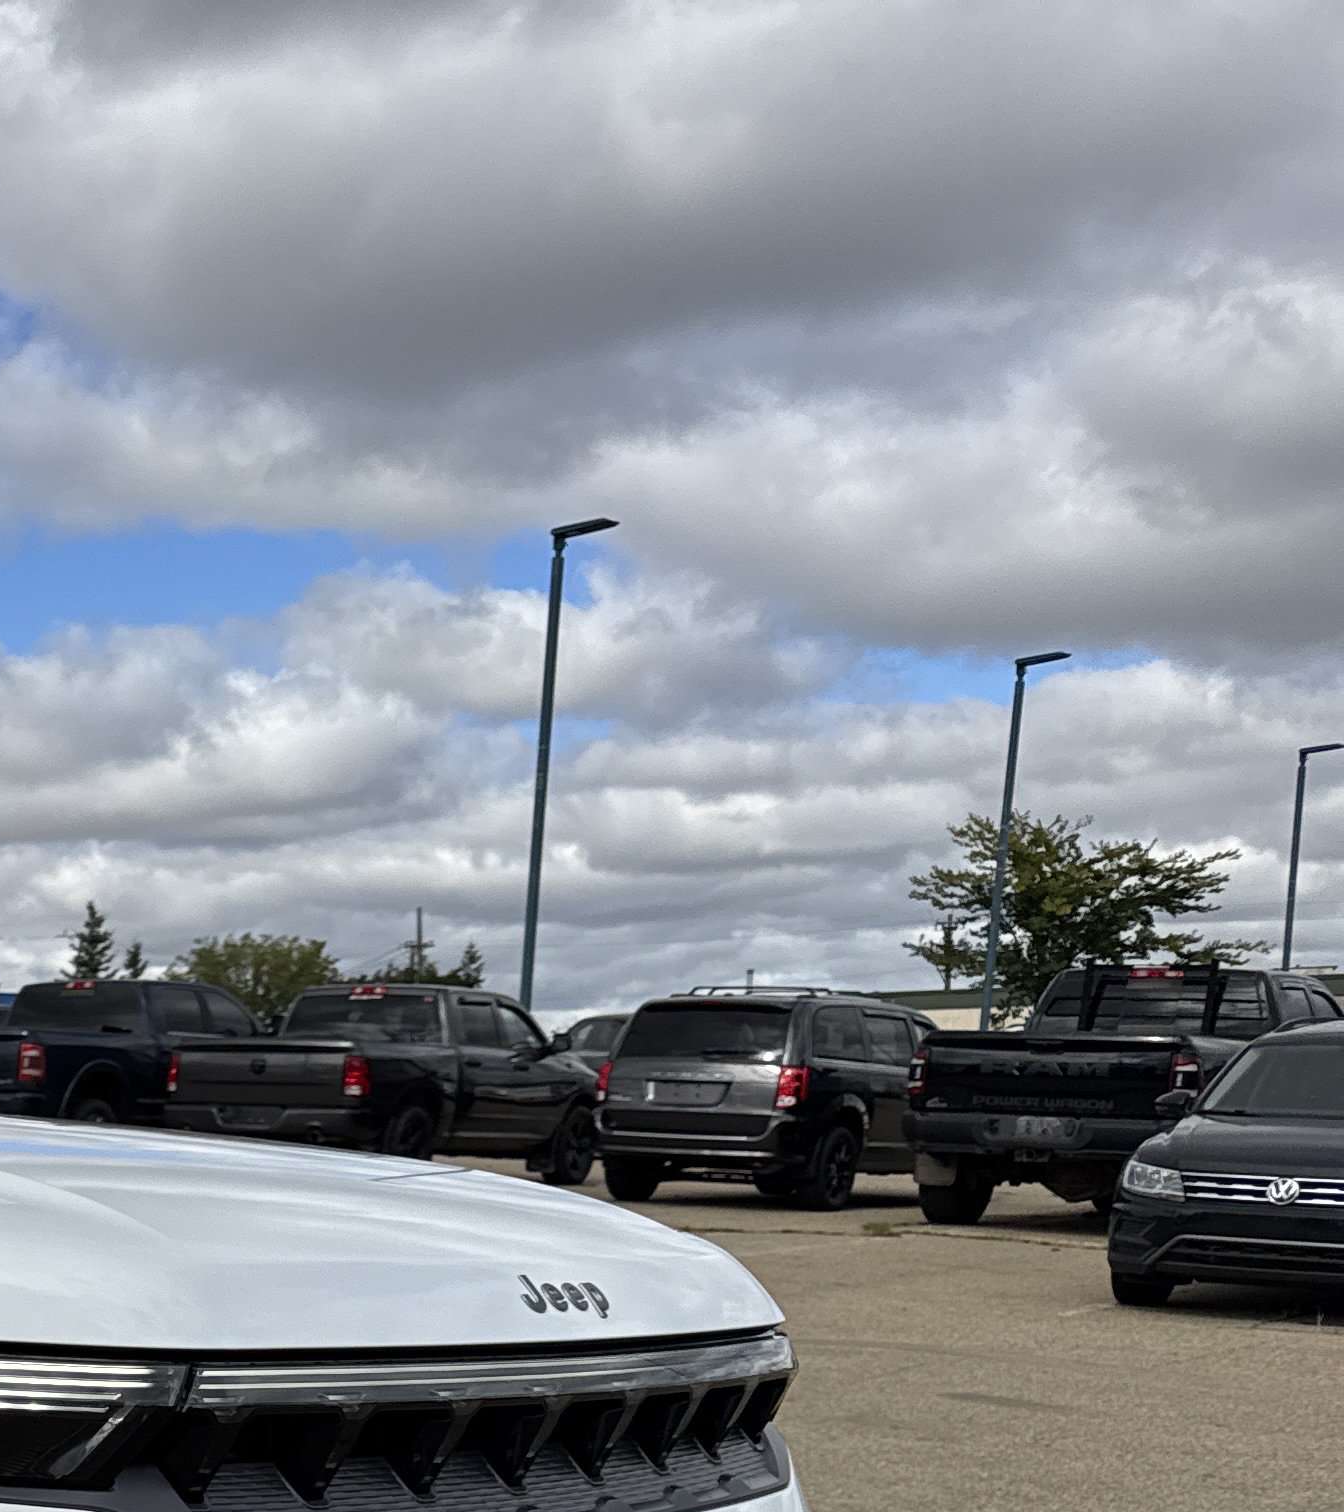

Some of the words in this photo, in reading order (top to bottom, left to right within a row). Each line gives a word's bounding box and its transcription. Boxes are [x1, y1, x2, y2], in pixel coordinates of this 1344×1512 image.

[982, 1061, 1111, 1078] RAM
[972, 1095, 1040, 1110] POWER
[1045, 1096, 1115, 1112] WAGON
[518, 1274, 610, 1319] Jeep
